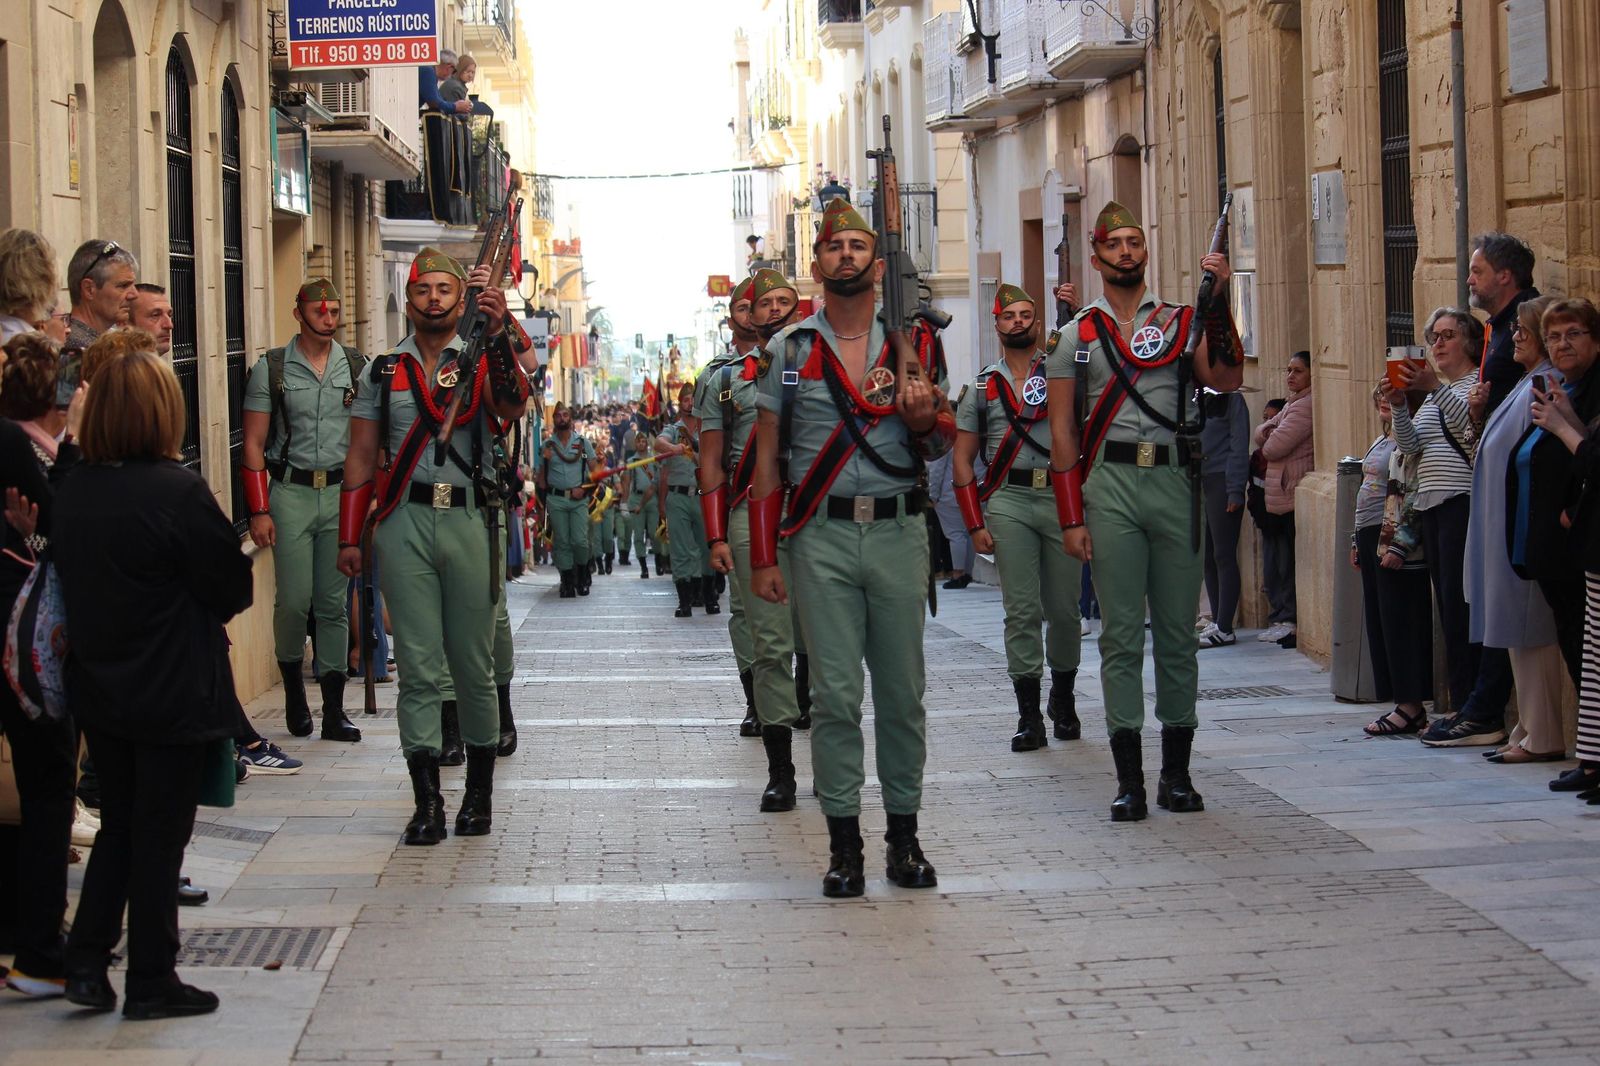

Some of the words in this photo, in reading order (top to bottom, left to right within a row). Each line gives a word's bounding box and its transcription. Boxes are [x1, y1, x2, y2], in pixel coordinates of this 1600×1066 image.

[297, 16, 364, 35] TERRENOS
[368, 11, 430, 32] RÚSTICOS
[298, 46, 324, 64] Tlf.
[328, 45, 358, 62] 950
[363, 44, 382, 61] 39
[386, 43, 406, 60] 08
[411, 42, 430, 59] 03
